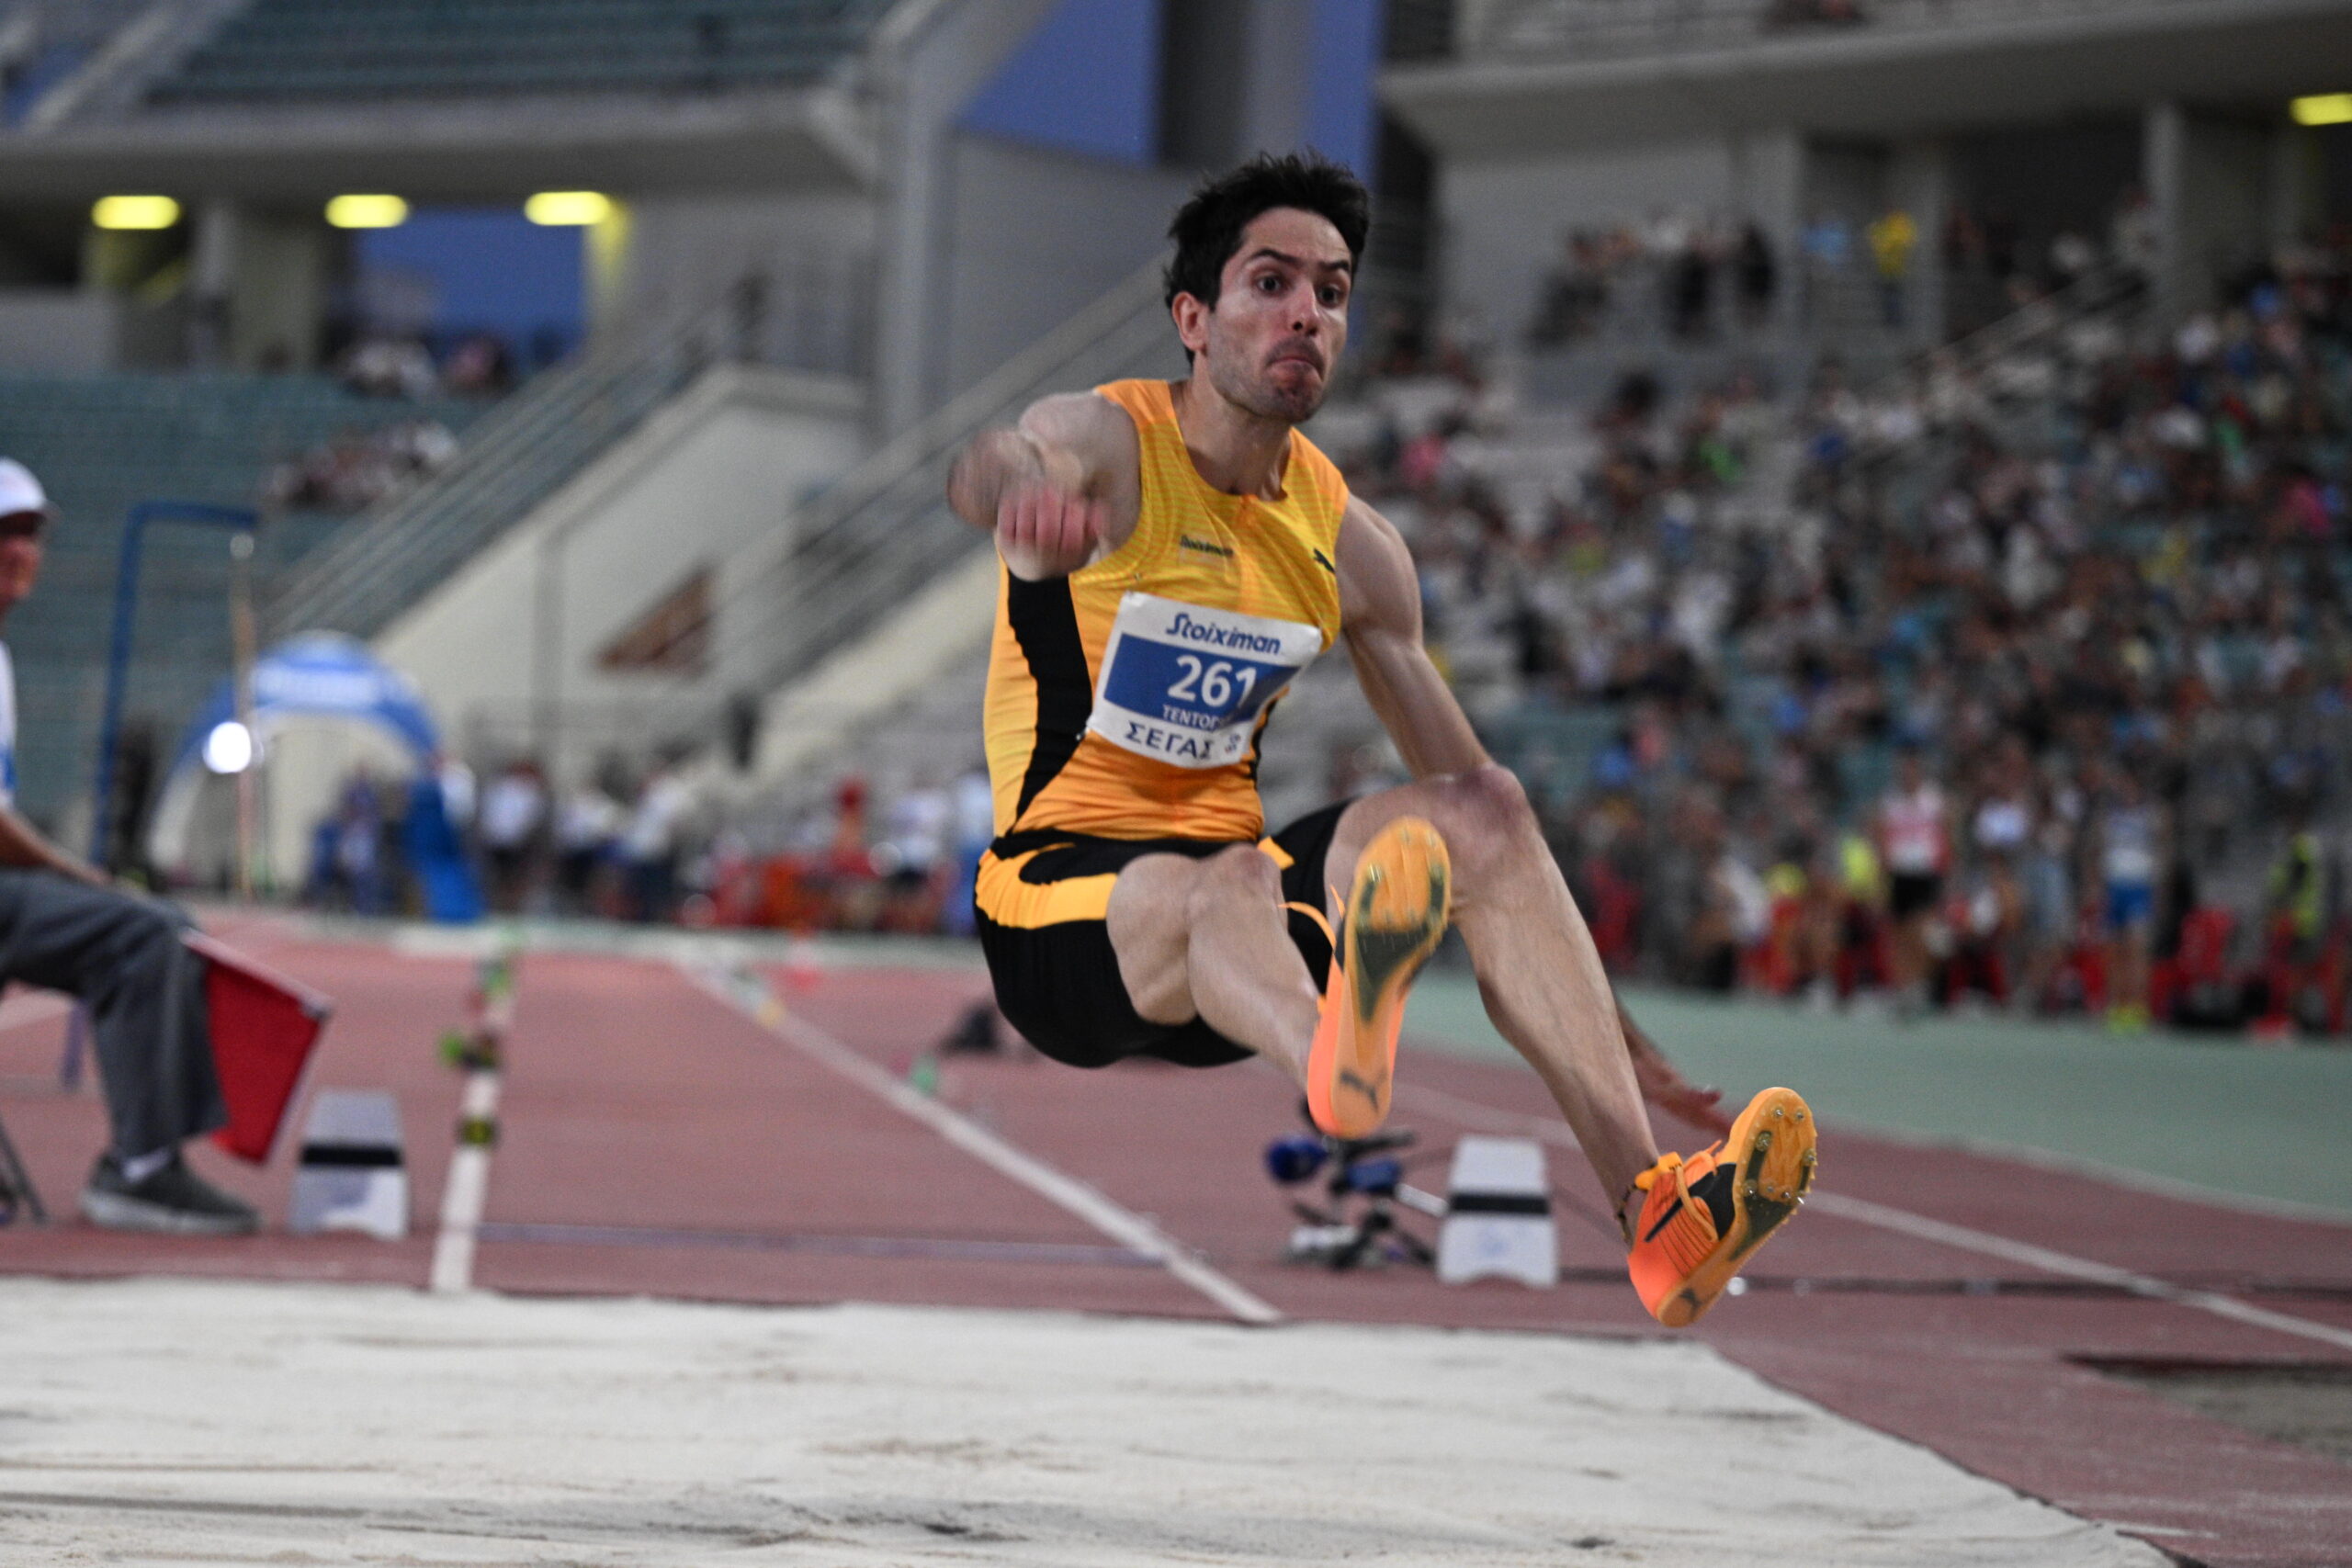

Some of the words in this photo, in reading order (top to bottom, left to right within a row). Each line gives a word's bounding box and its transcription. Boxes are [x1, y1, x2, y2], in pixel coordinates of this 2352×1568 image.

[1166, 613, 1281, 655] Stoiximan
[1168, 655, 1257, 707] 261
[1162, 705, 1224, 731] ΤΕΝΤΟΓ
[1125, 722, 1214, 760] ΣΕΓΑΣ
